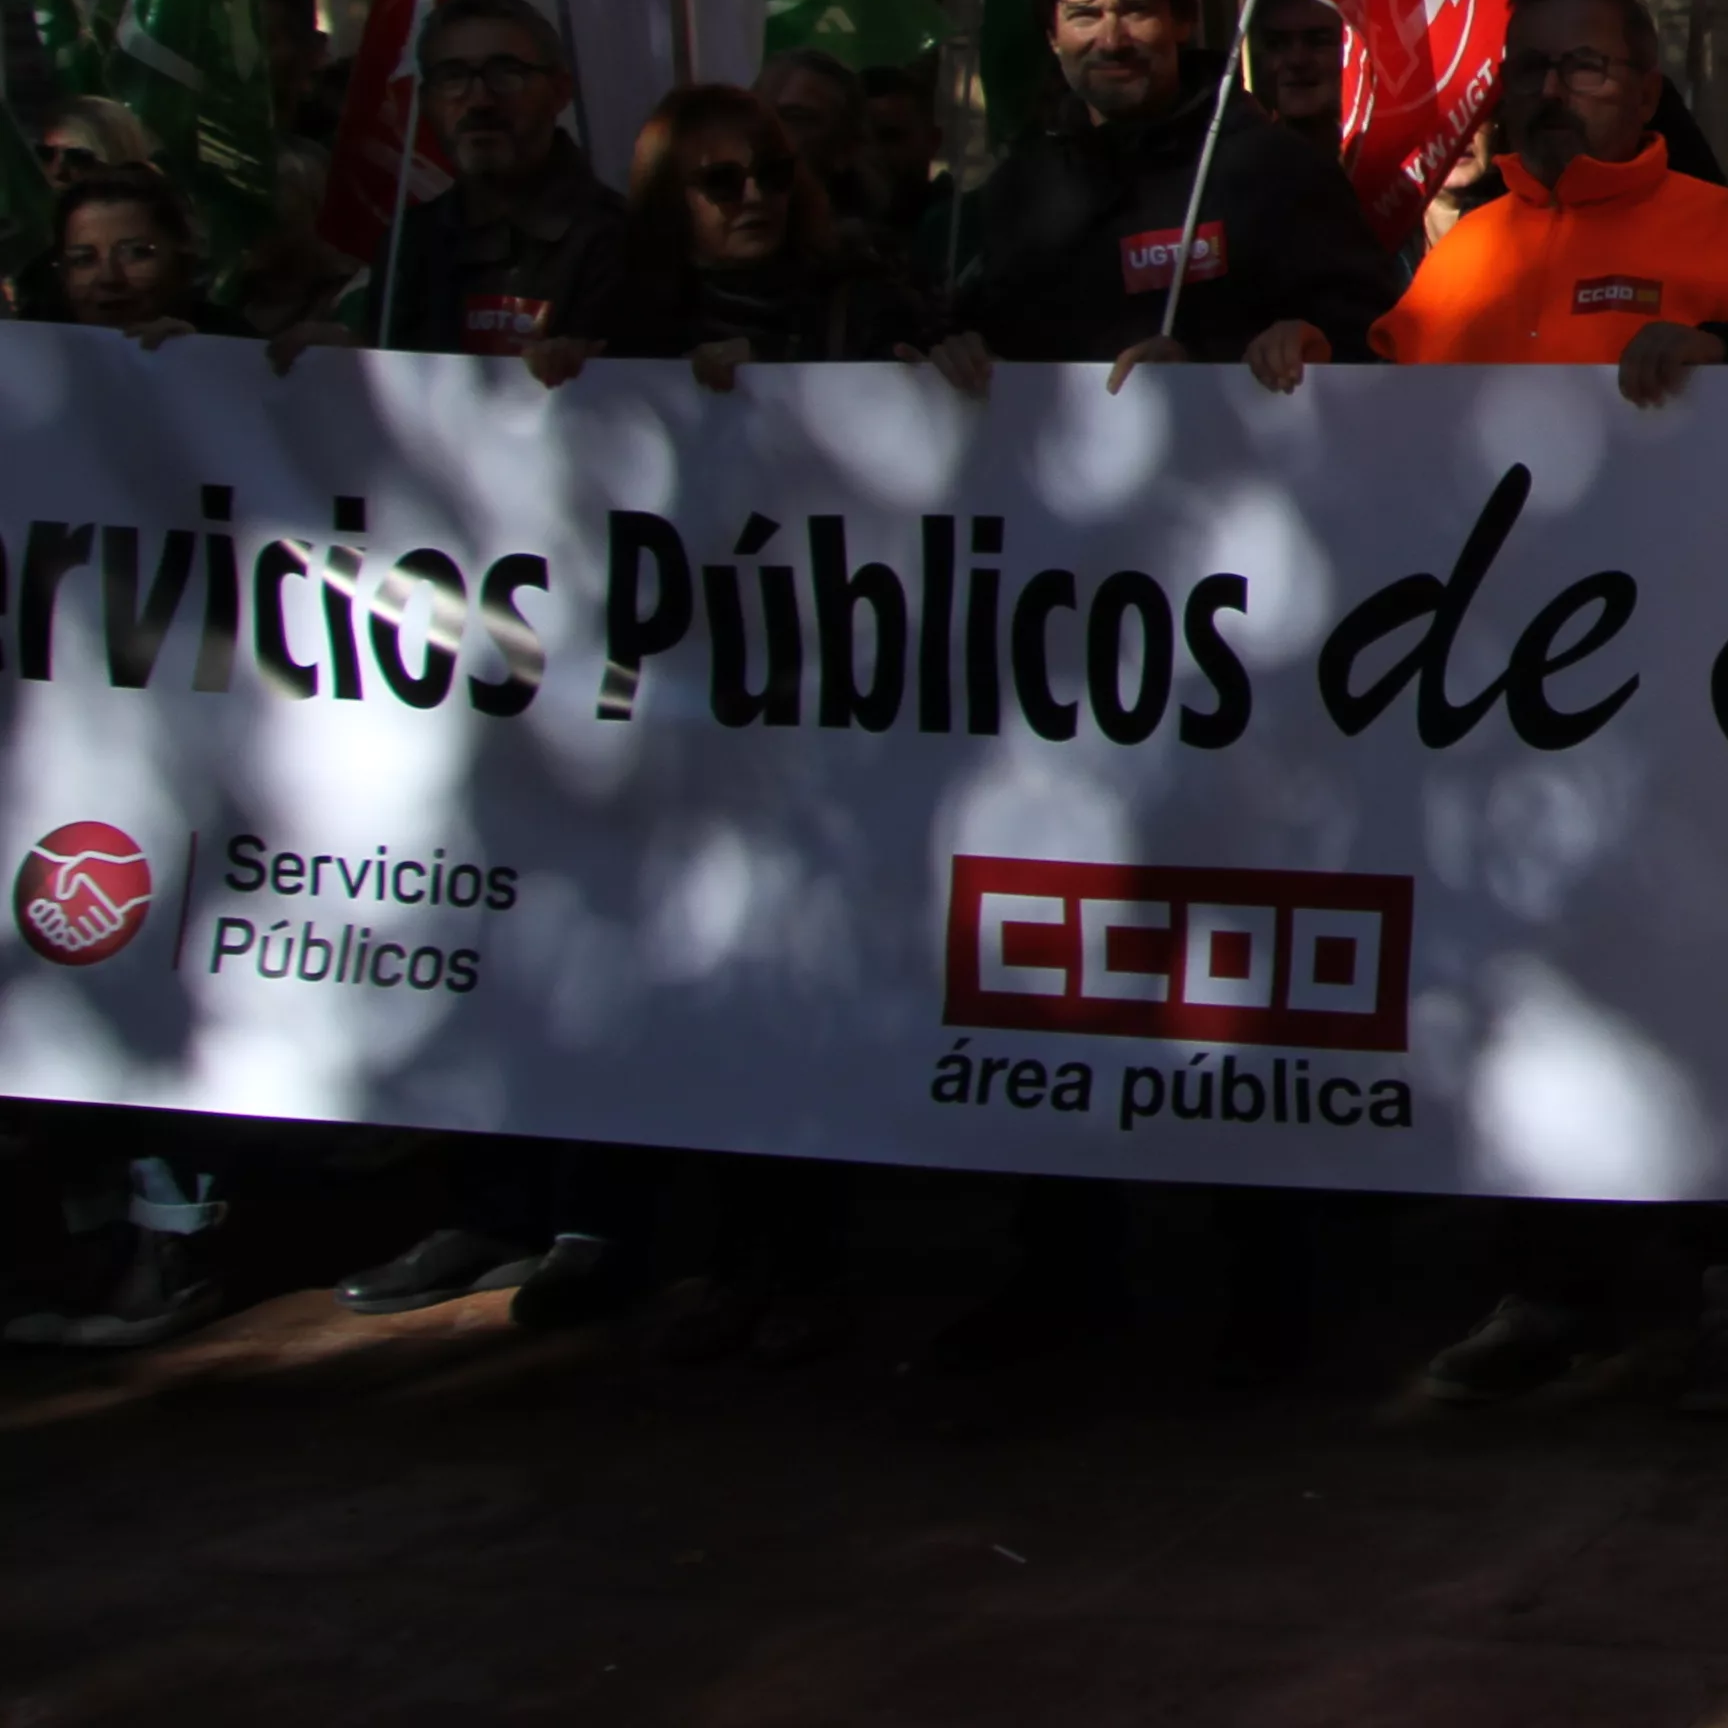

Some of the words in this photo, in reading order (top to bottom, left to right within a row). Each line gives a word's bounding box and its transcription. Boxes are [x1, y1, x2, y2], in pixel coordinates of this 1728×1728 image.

[1577, 285, 1635, 304] CCOO
[0, 484, 551, 717] rvicios
[596, 508, 1252, 750] Públicos
[1316, 462, 1641, 750] de
[223, 833, 519, 912] Servicios
[209, 916, 481, 994] Públicos
[978, 890, 1384, 1016] CCOO
[930, 1036, 1093, 1112] área
[1119, 1052, 1414, 1132] pública
